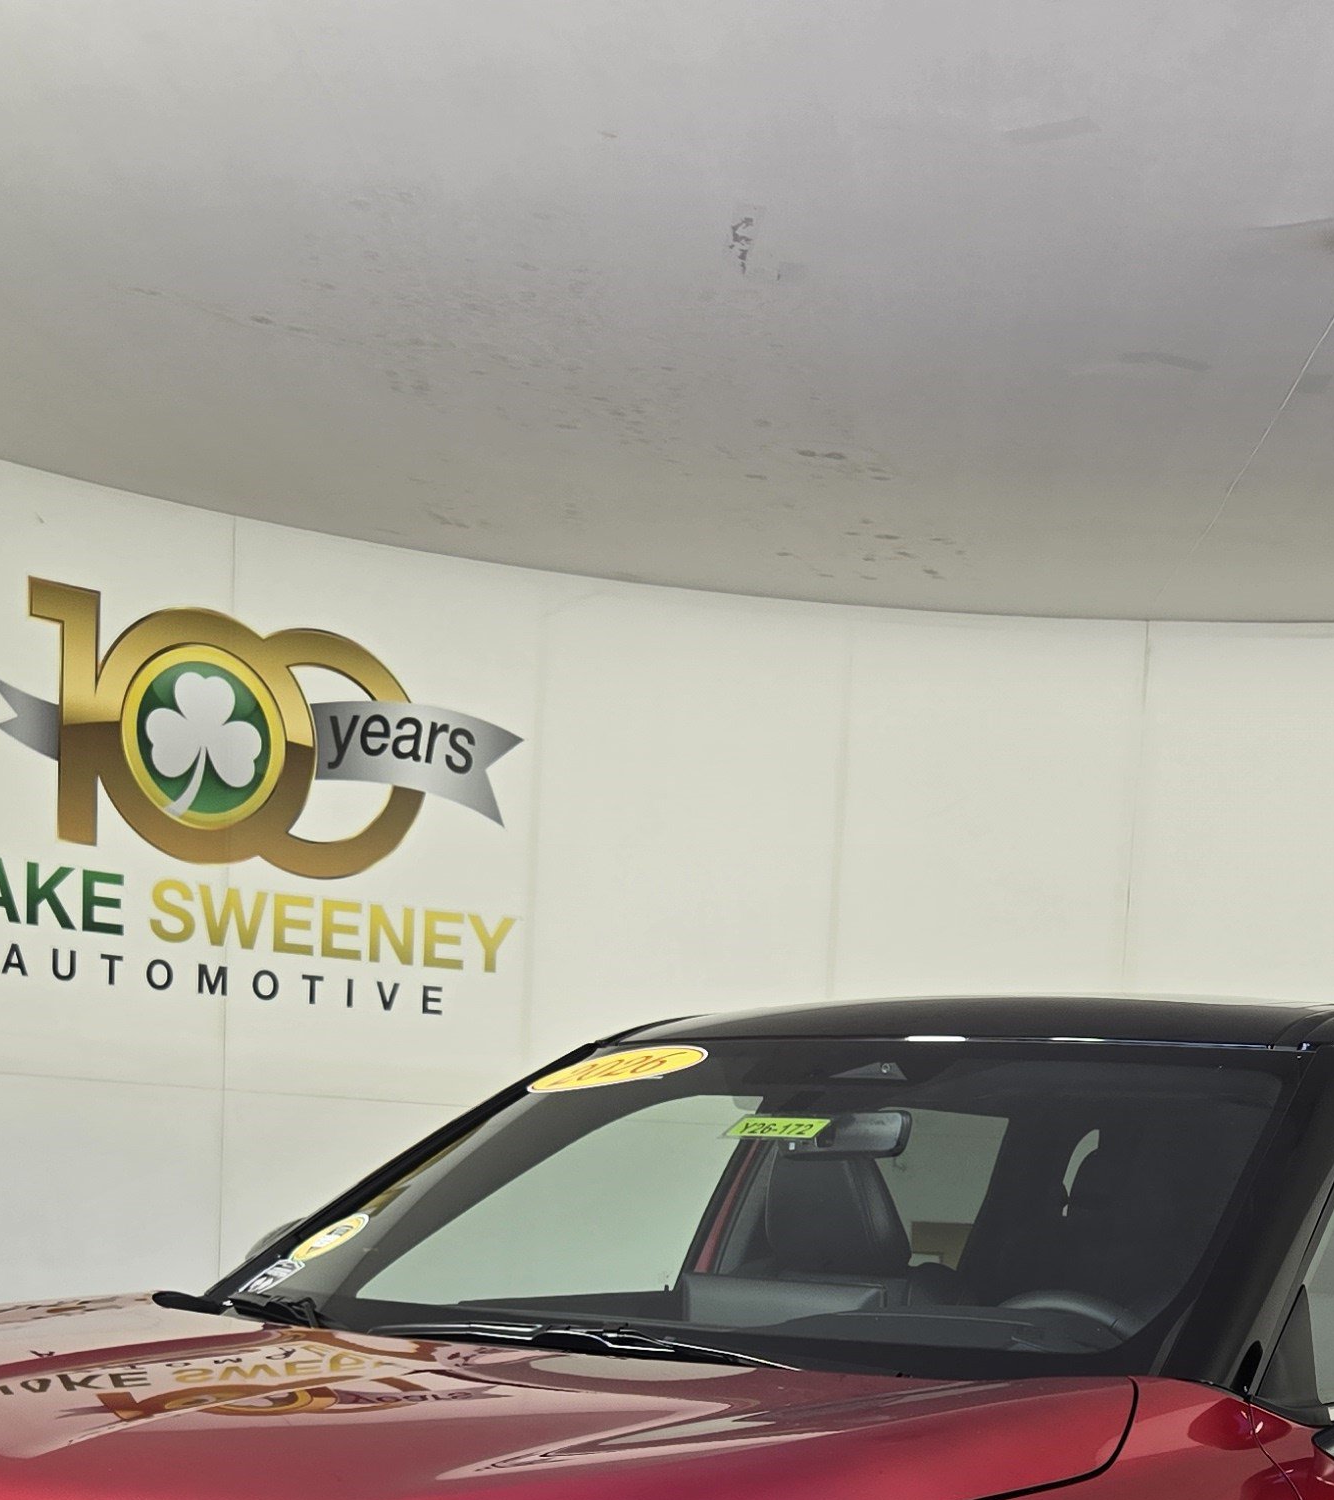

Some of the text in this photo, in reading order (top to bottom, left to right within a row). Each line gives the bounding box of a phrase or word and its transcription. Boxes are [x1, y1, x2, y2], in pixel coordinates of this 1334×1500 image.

[28, 575, 476, 880] 100 years
[149, 879, 517, 974] SWEENEY
[1, 943, 444, 1015] AUTOMOTIVE
[548, 1051, 687, 1087] 2026
[738, 1121, 814, 1136] Y26-172
